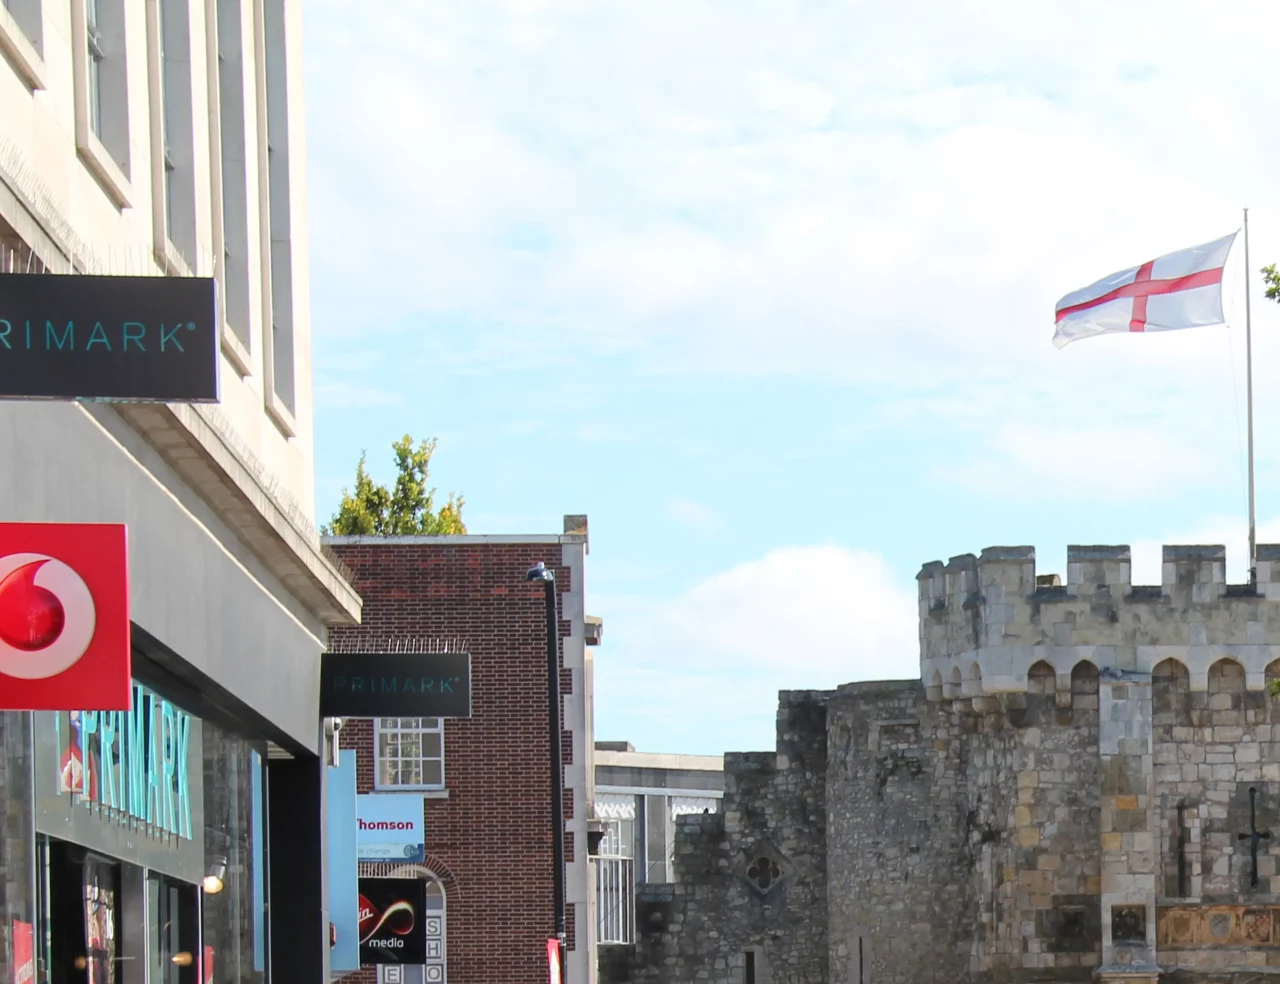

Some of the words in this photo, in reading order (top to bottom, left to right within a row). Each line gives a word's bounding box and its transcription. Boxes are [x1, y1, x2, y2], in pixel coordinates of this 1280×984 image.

[0, 318, 186, 353] RIMARK
[357, 818, 415, 831] homson
[368, 937, 404, 948] media
